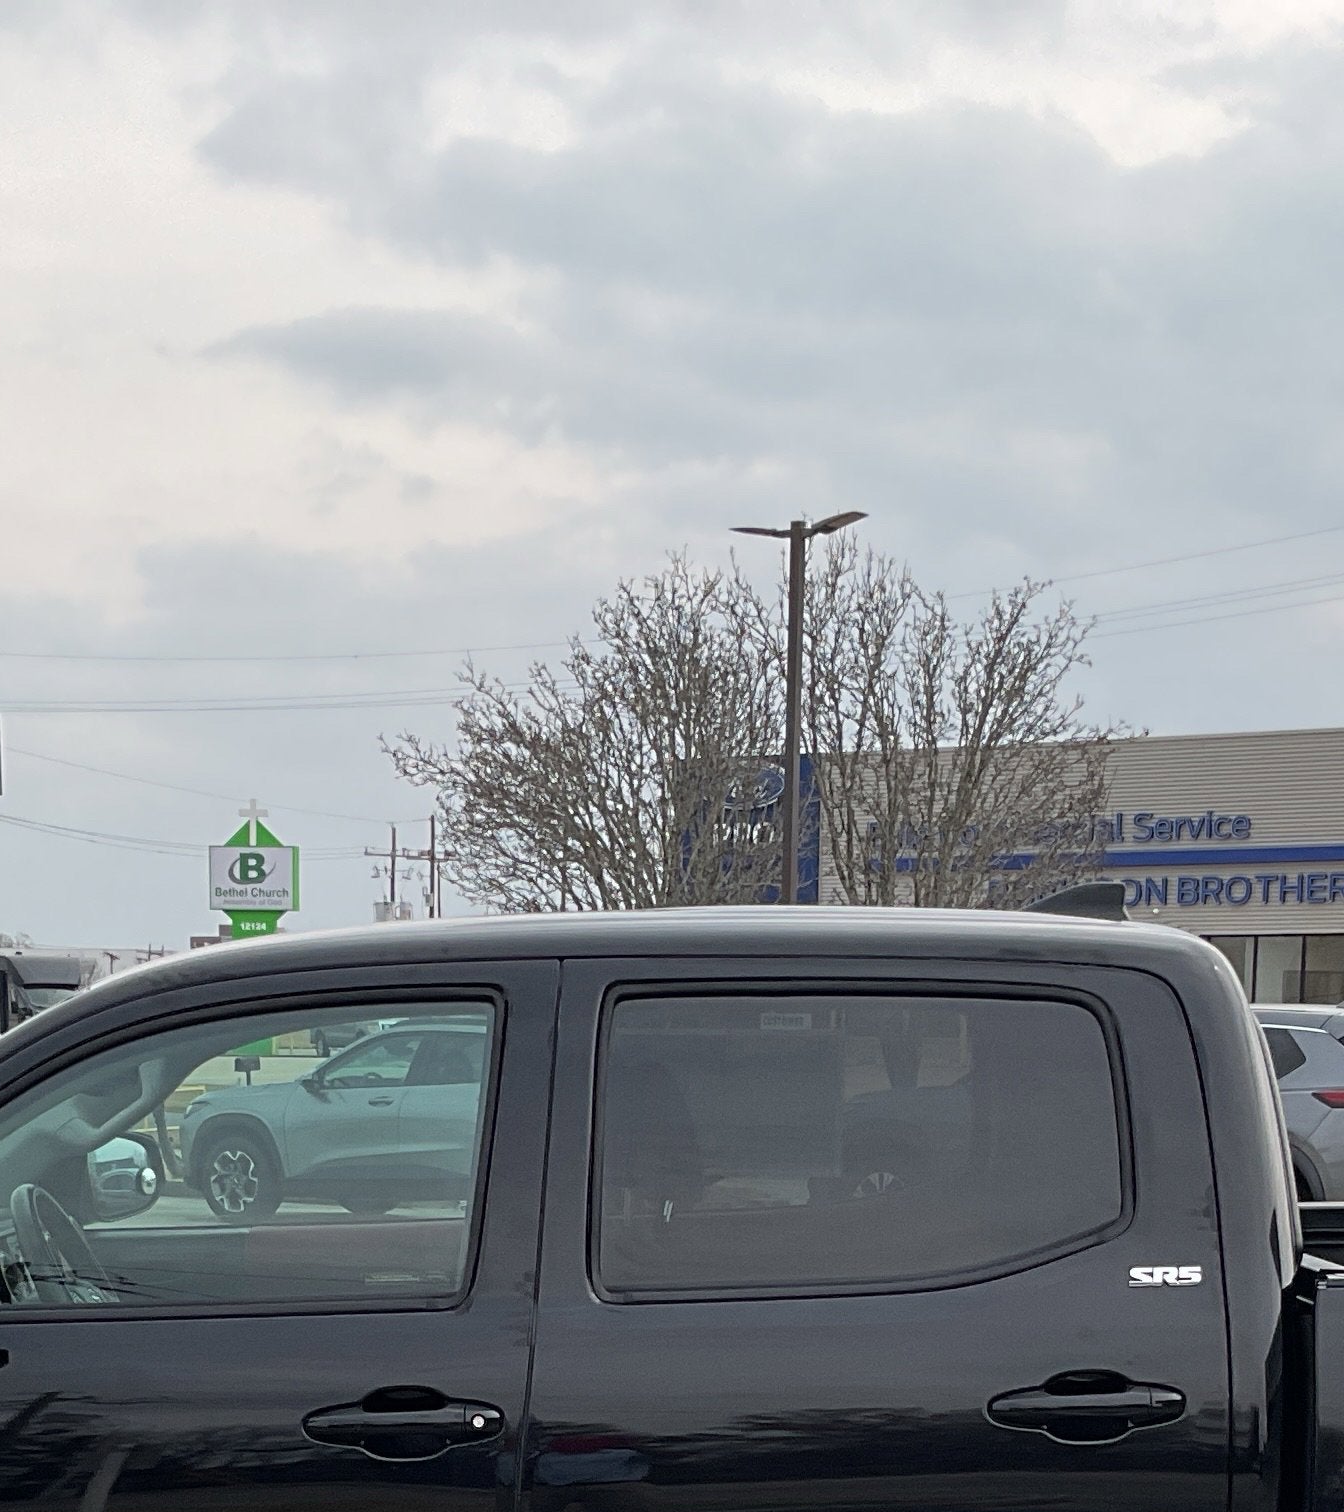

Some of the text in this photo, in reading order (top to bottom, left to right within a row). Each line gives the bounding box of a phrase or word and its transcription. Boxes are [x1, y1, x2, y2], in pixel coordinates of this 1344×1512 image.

[1132, 810, 1251, 842] Service
[239, 852, 267, 881] B
[215, 887, 289, 898] Bethel Church
[1128, 1266, 1202, 1287] SR5
